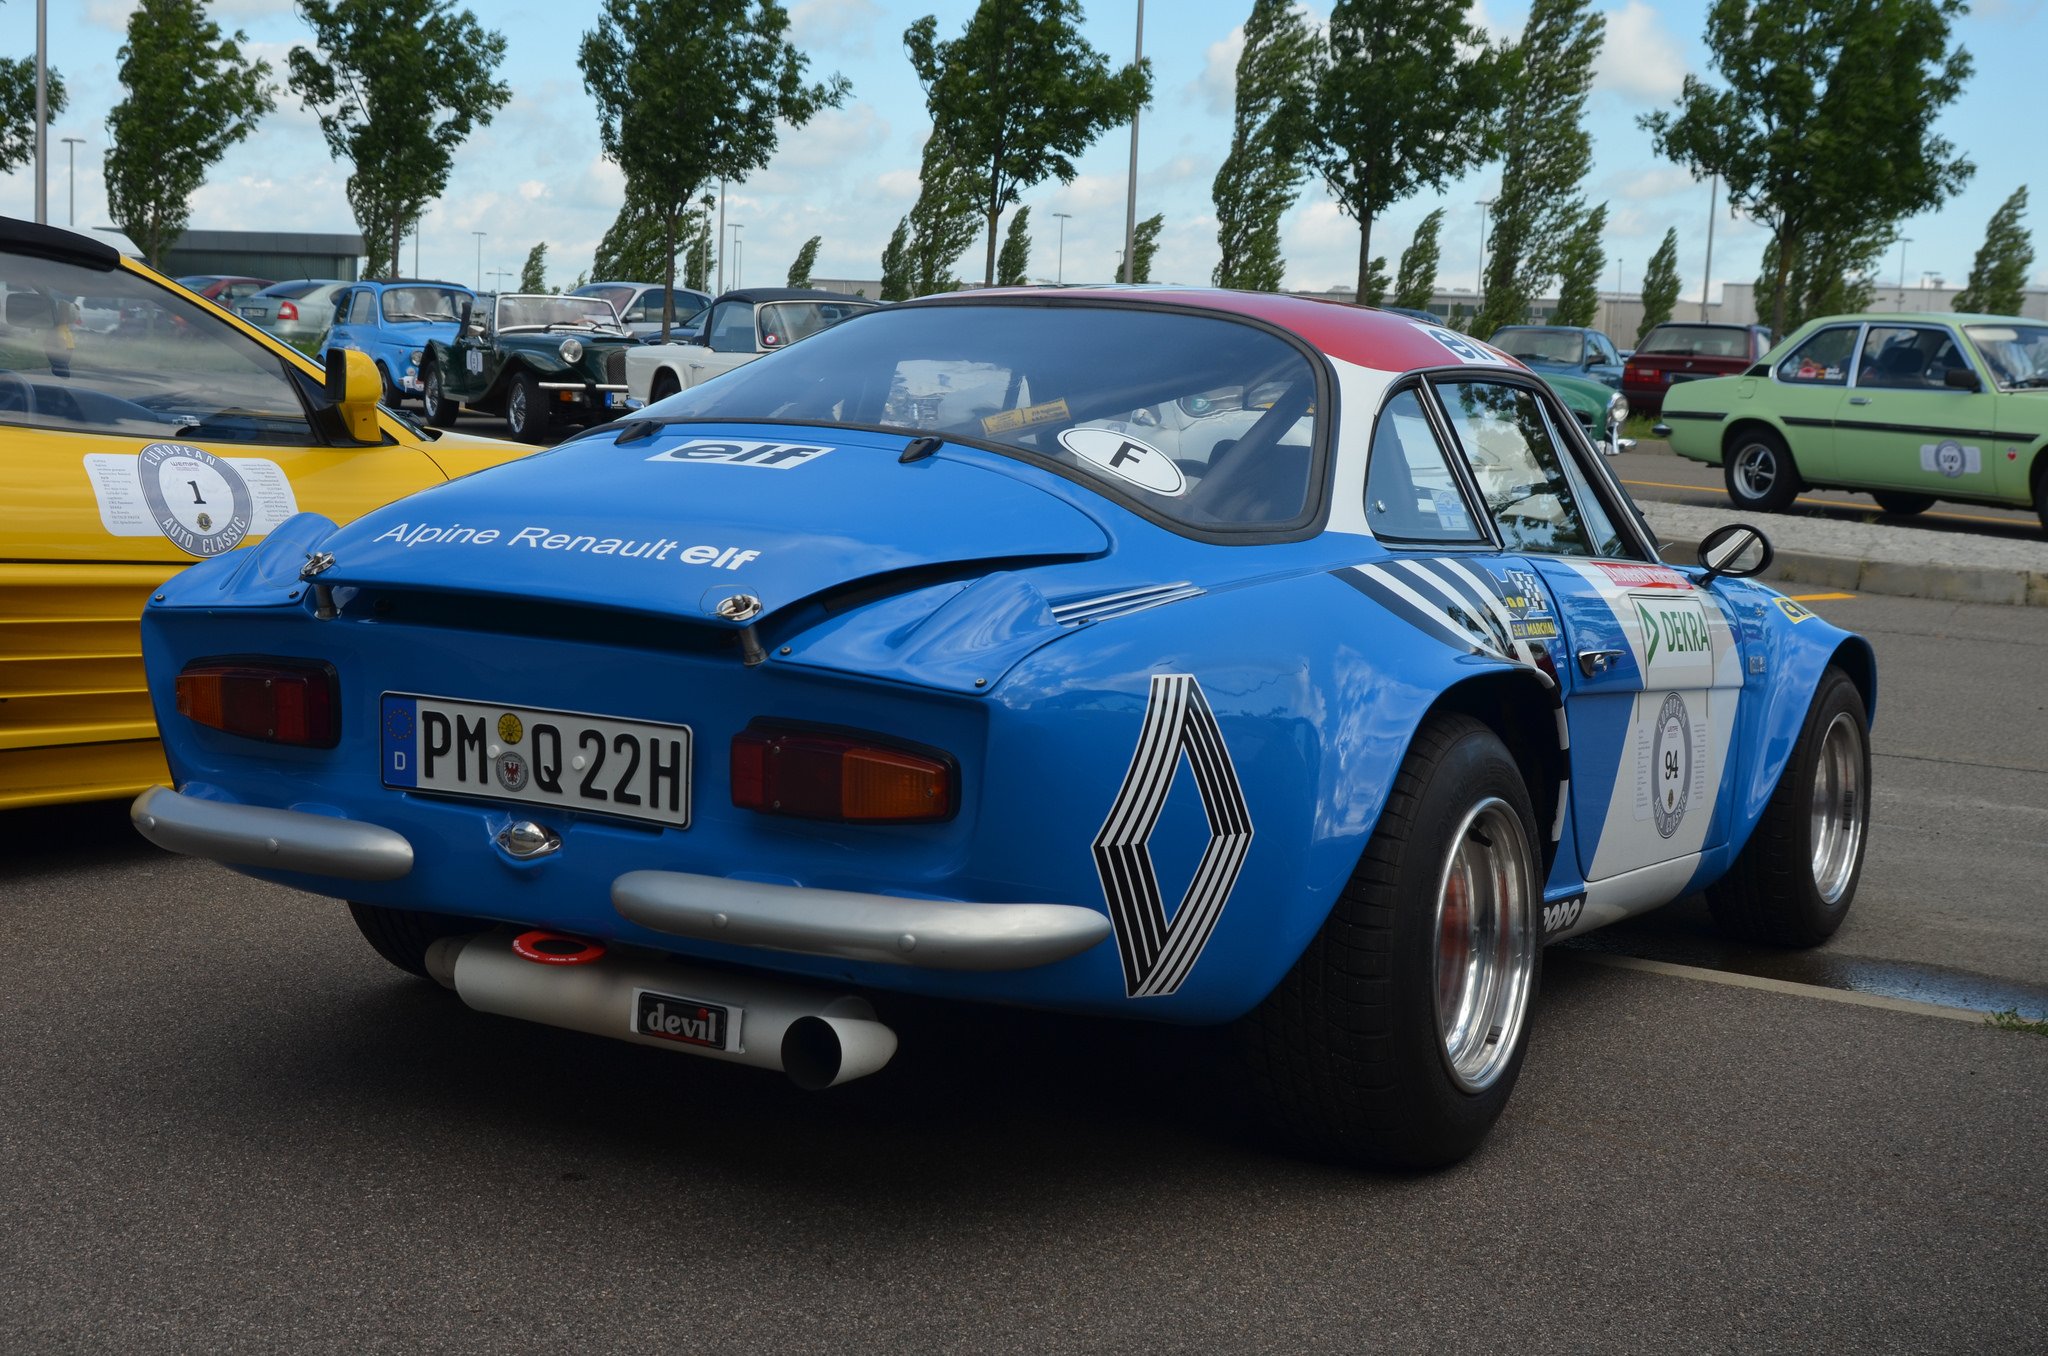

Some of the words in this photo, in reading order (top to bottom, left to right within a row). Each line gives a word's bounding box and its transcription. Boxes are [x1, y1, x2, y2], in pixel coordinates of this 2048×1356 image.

[144, 443, 216, 467] EUROPEAN
[670, 443, 824, 466] elf
[1108, 440, 1148, 469] F
[187, 480, 207, 505] 1
[163, 517, 194, 549] AUTO
[202, 516, 246, 554] CLASSIC
[373, 522, 500, 548] Alpine
[507, 526, 678, 561] Renault
[680, 544, 761, 571] elf
[1659, 611, 1711, 653] DEKRA
[394, 751, 406, 771] D
[422, 710, 489, 784] PM
[531, 723, 563, 794] Q
[579, 729, 681, 812] 22H
[1665, 750, 1679, 780] 94
[647, 1003, 717, 1042] devil
